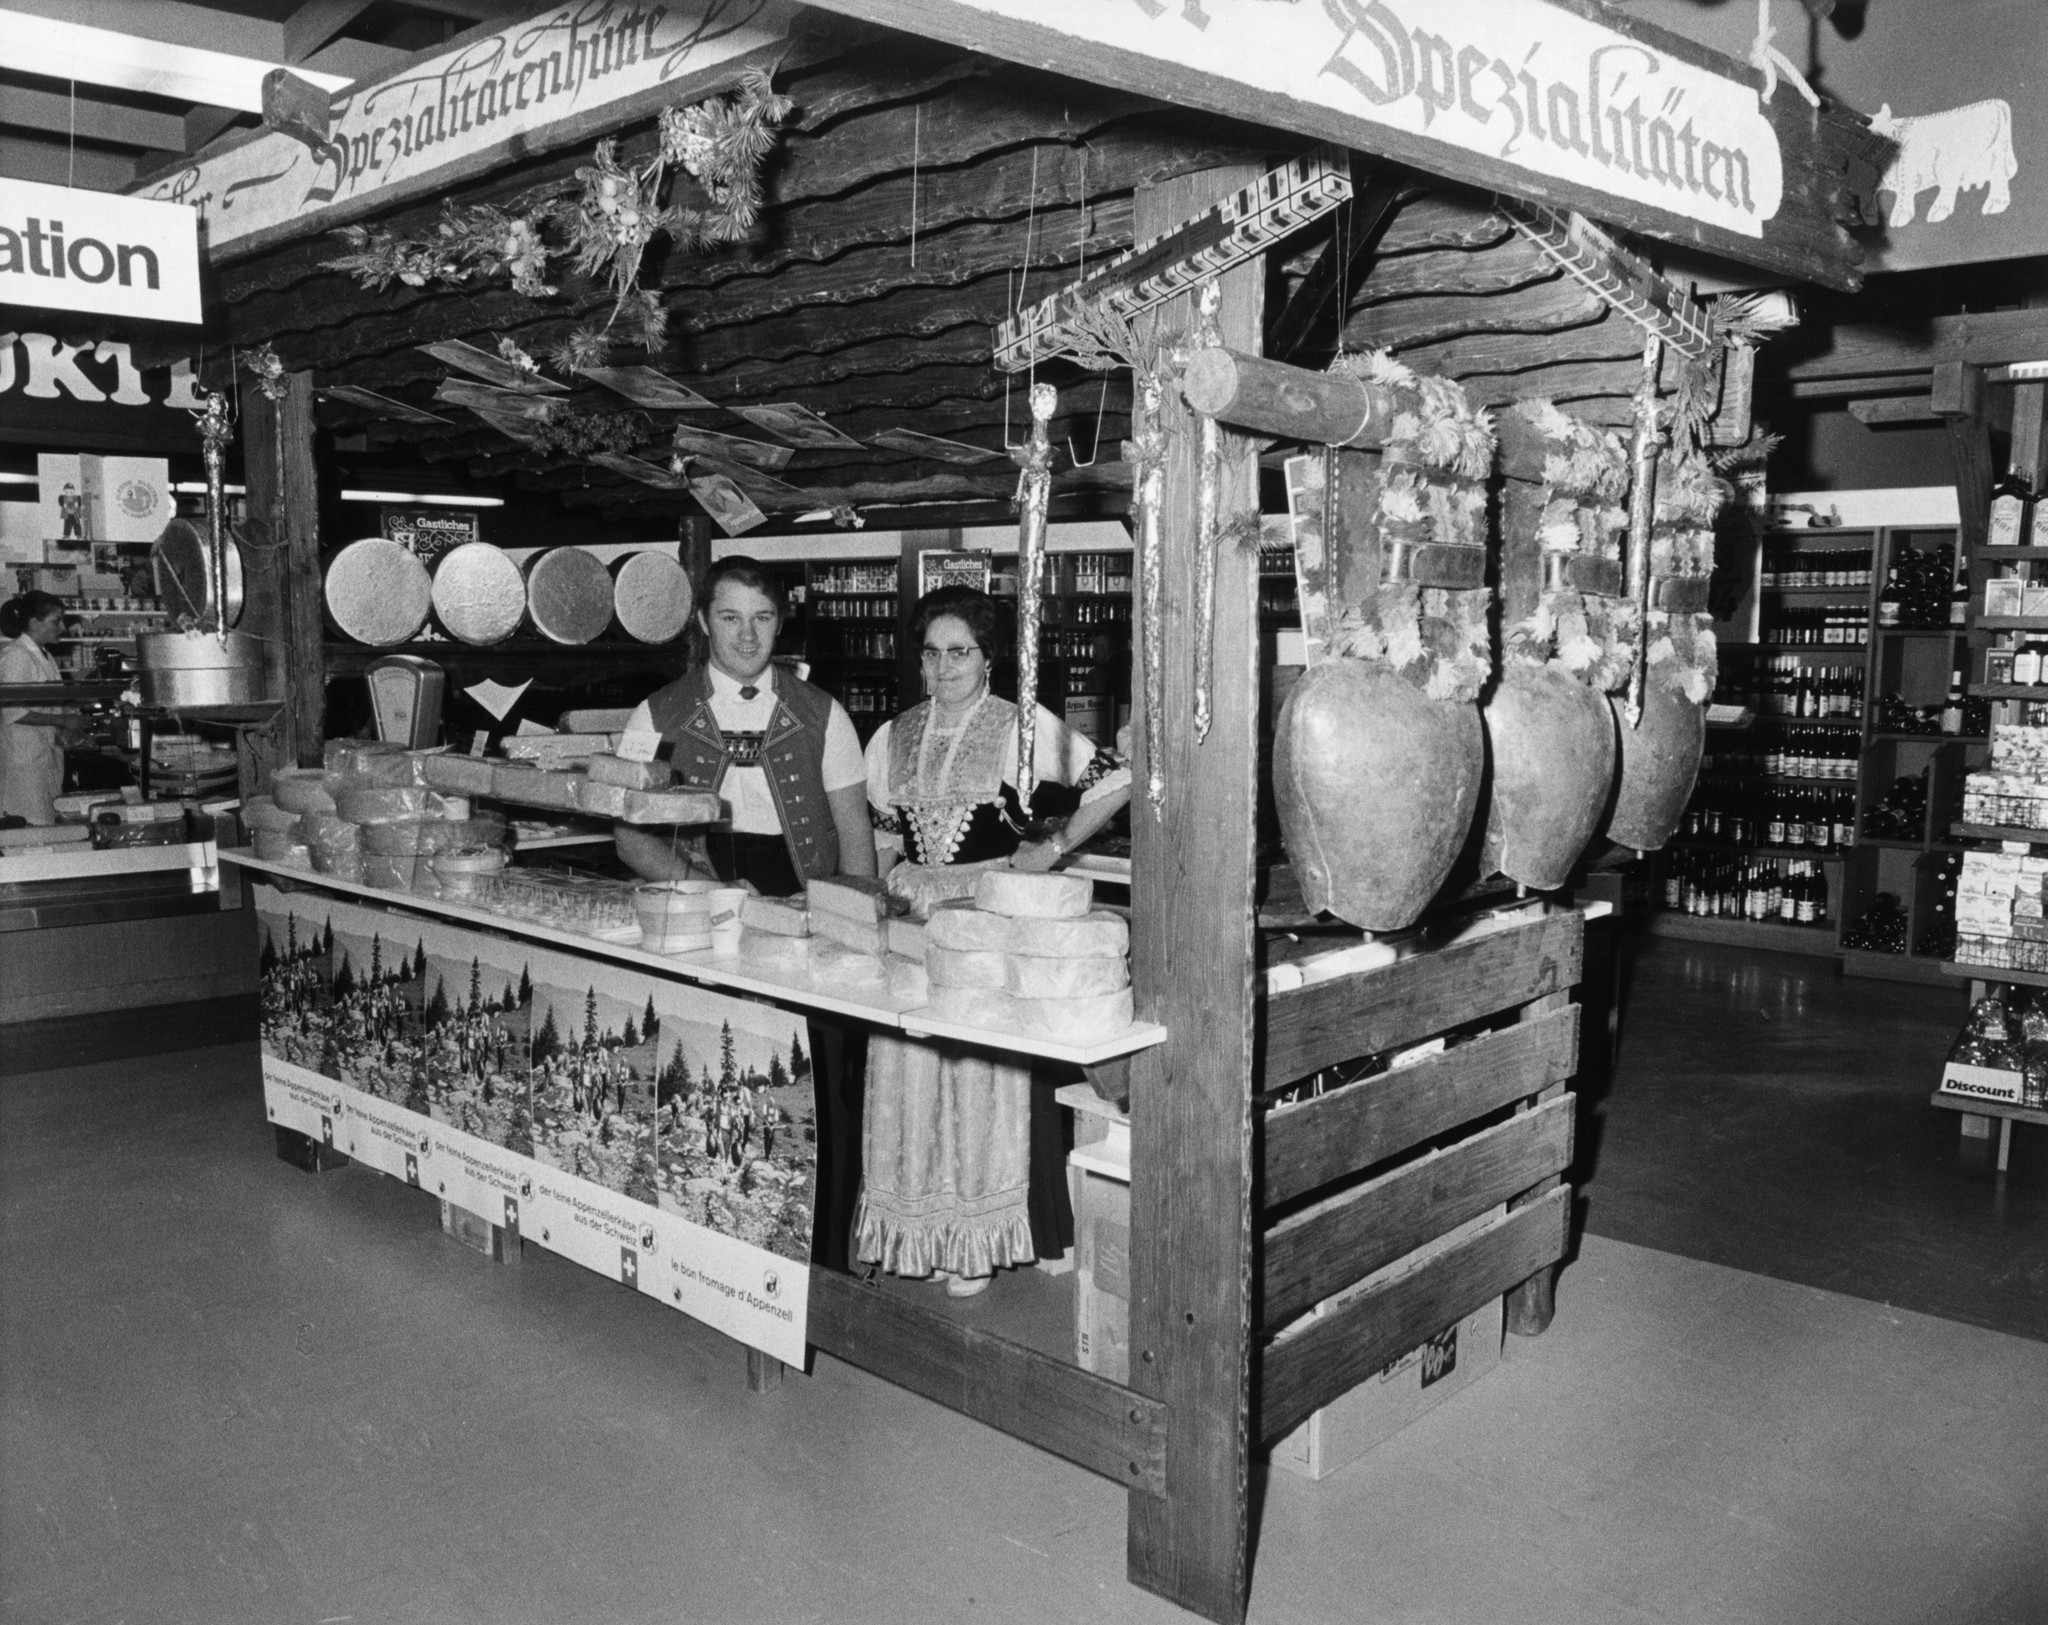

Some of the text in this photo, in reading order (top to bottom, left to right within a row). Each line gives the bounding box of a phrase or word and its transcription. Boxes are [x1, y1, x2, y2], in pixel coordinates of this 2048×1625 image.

[1317, 0, 1756, 215] Spezialitäten
[416, 517, 470, 531] Gastliches
[1945, 1078, 2016, 1099] Discount
[538, 1185, 552, 1196] der
[589, 1219, 603, 1230] der
[603, 1222, 638, 1247] Schweiz
[670, 1258, 794, 1324] le bon fromage d'Appenzell
